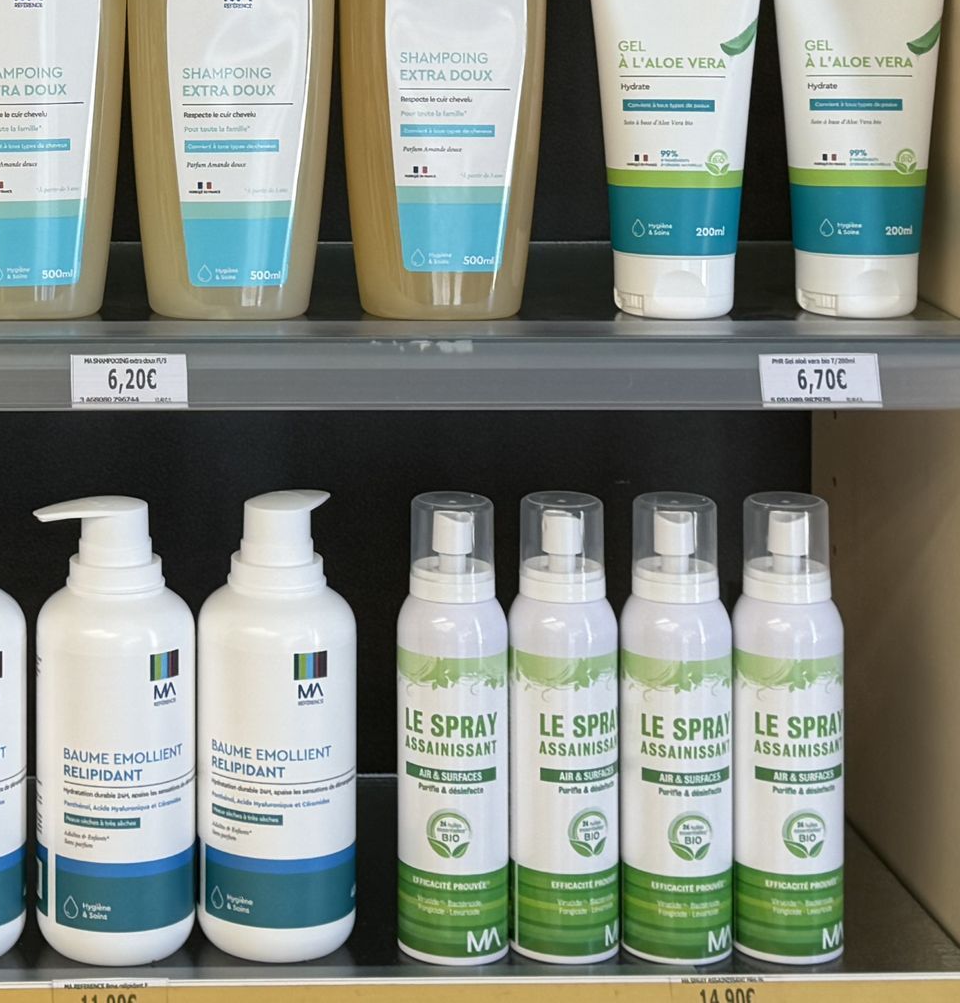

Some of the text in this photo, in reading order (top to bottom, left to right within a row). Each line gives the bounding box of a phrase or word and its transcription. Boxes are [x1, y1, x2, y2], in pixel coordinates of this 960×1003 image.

[618, 40, 646, 52] GEL
[805, 39, 833, 52] GEL
[400, 52, 488, 65] SHAMPOING
[619, 53, 726, 69] À L'ALOE VERA
[805, 53, 913, 69] À L'ALOE VERA
[400, 69, 493, 82] EXTRA DOUX
[620, 83, 650, 92] Hydrate
[661, 149, 679, 159] 99%
[187, 161, 206, 169] Parfum
[696, 225, 725, 237] 200ml
[108, 368, 157, 394] 6,20€
[797, 368, 847, 394] 6,70€
[406, 707, 498, 739] LE SPRAY
[641, 710, 730, 741] LE SPRAY
[211, 738, 332, 762] BAUME EMOLLIENT
[405, 734, 497, 758] ASSAINISSANT
[63, 743, 183, 765] BAUME EMOLLIENT
[63, 764, 143, 782] RELIPIDANT
[211, 755, 286, 779] RELIPIDANT
[419, 767, 483, 782] AIR & SURFACES
[418, 782, 484, 795] Purifie & désinfecte
[442, 833, 460, 843] BIO
[467, 927, 501, 953] MA
[700, 988, 755, 1003] 1490€
